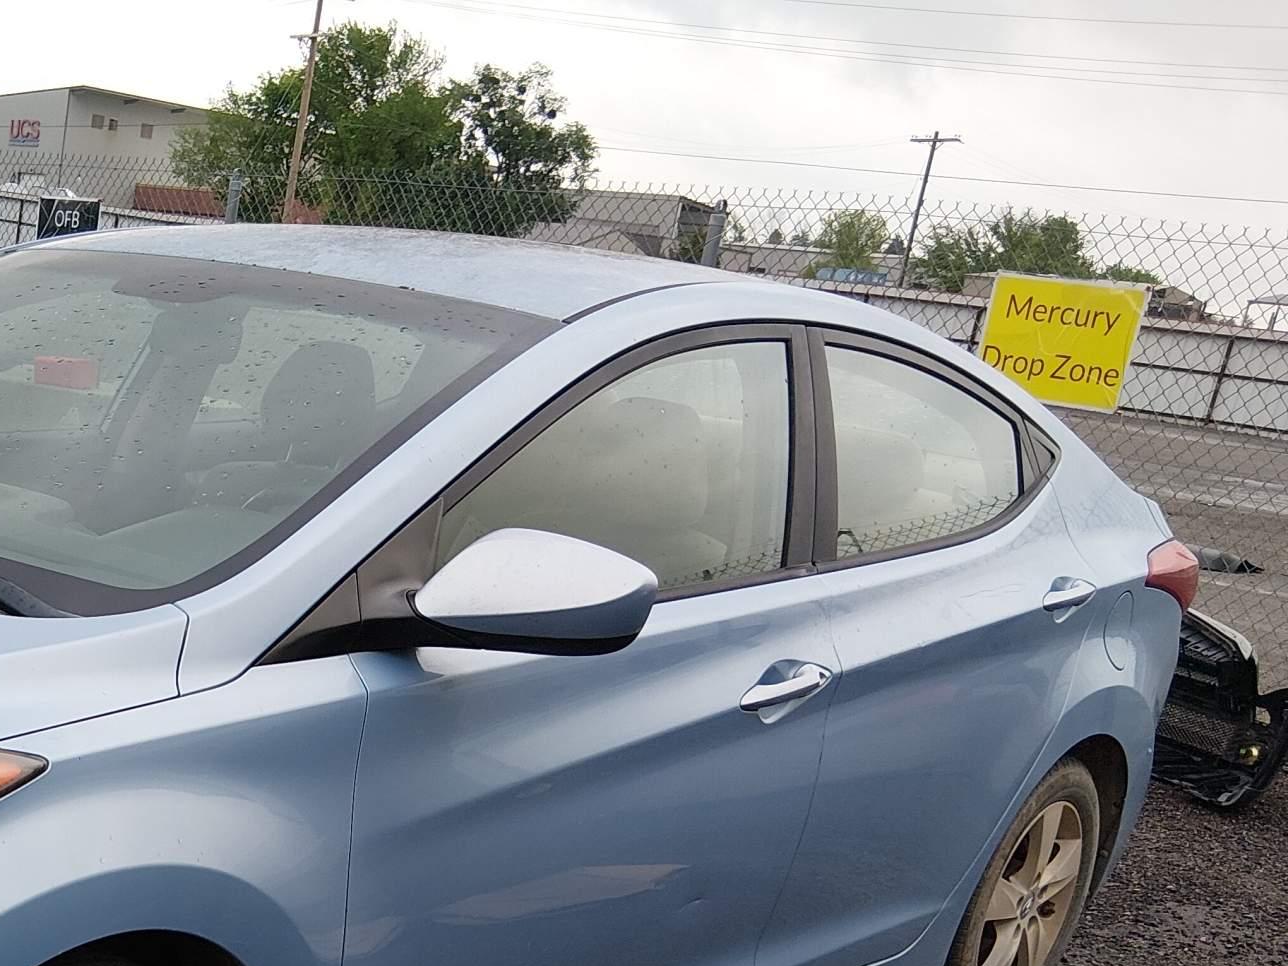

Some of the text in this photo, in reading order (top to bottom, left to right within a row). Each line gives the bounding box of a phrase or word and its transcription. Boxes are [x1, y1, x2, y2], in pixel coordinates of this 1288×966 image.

[10, 119, 41, 140] UCS
[54, 210, 80, 229] OFB
[1005, 294, 1121, 336] Mercury
[982, 344, 1120, 388] Drop Zone
